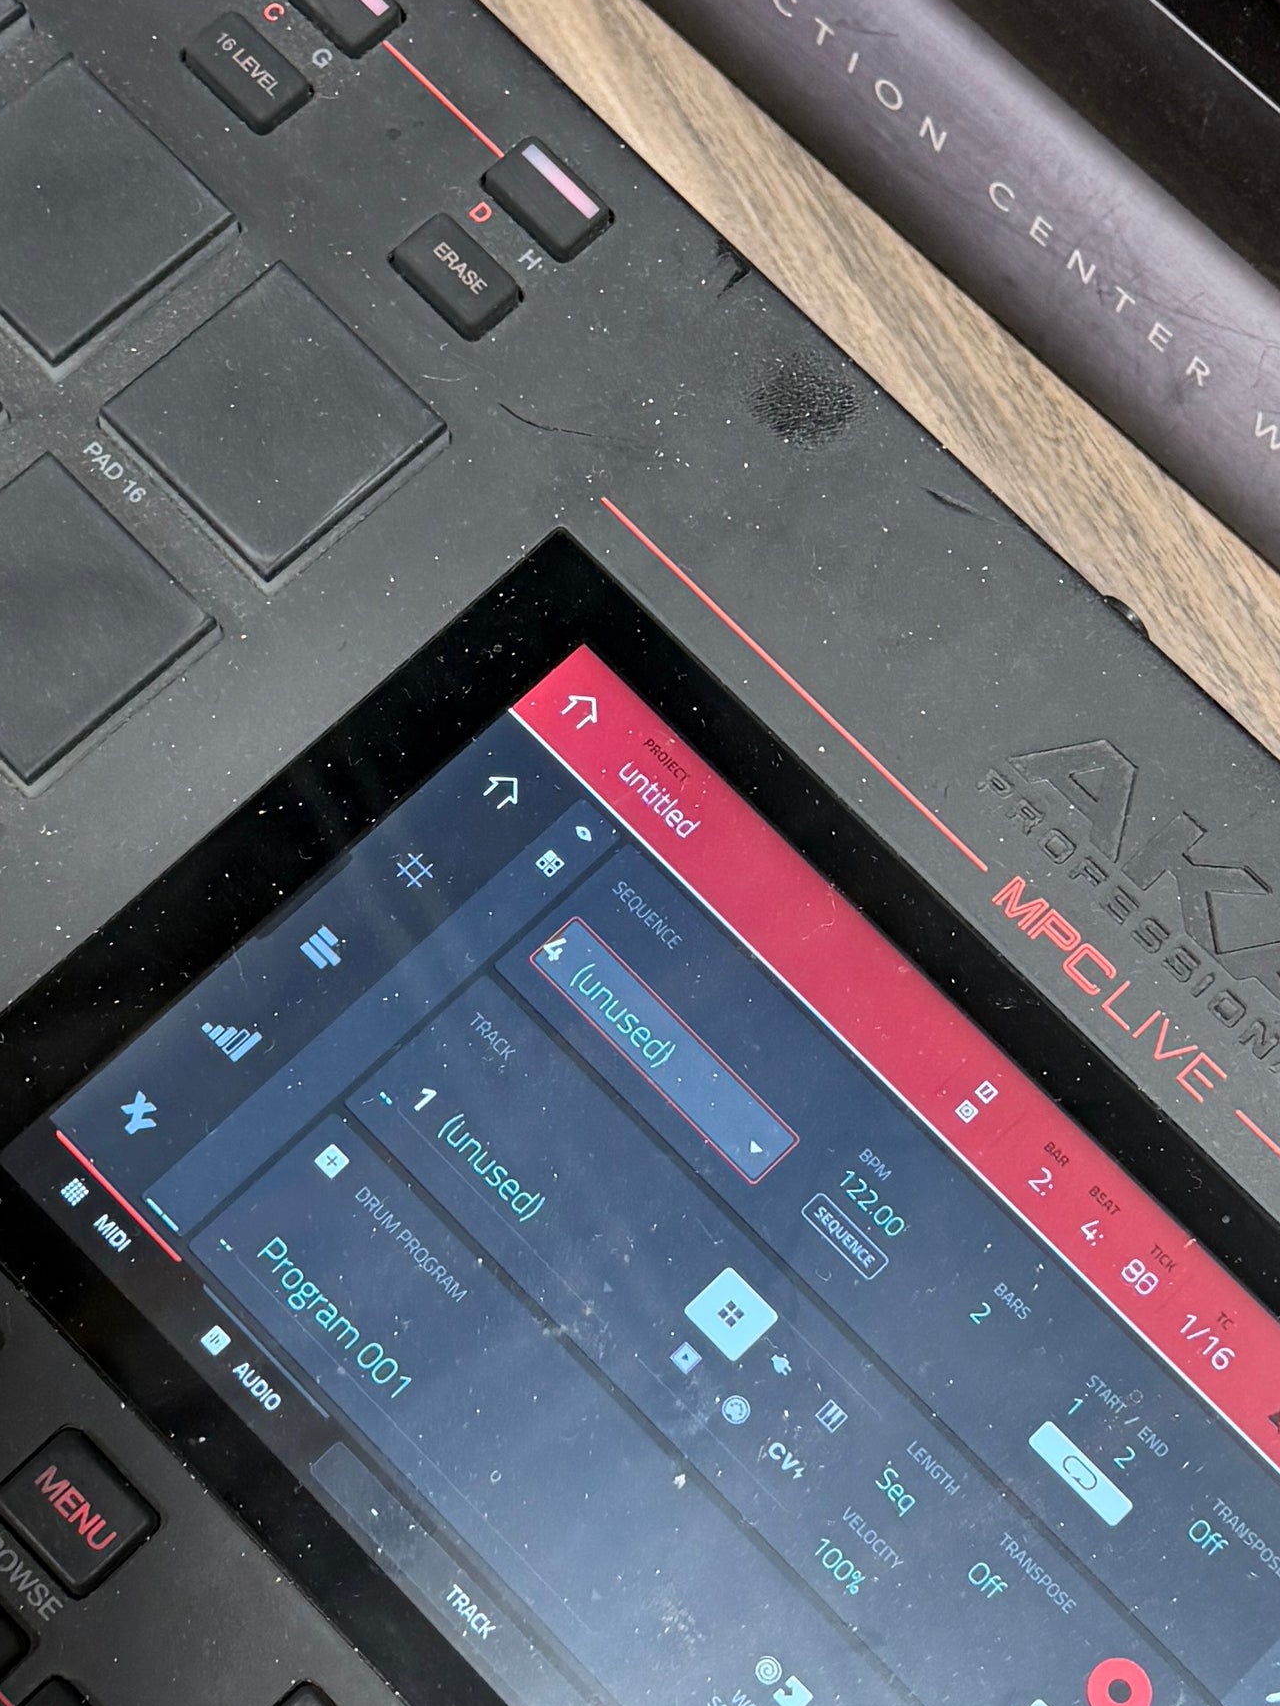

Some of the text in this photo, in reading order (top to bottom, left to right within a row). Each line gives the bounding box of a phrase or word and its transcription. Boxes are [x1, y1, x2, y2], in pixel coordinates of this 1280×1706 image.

[216, 31, 283, 98] 16 LEVEL
[433, 241, 488, 296] ERASE
[988, 181, 1213, 387] CENTER
[84, 440, 147, 504] PAD 16
[618, 759, 702, 840] untitled
[611, 879, 684, 951] SEQUENCE
[542, 937, 677, 1070] 4 (unused)
[469, 1011, 517, 1061] TRACK
[414, 1087, 547, 1223] 1 (unused)
[858, 1148, 893, 1182] BPM
[1043, 1141, 1070, 1168] BAR
[839, 1169, 905, 1237] 122.00
[1088, 1185, 1122, 1217] BEAT
[94, 1212, 132, 1254] MIDI
[354, 1185, 469, 1303] DRUM PROGRAM
[813, 1205, 877, 1270] SEQUENCE
[1149, 1244, 1178, 1273] TICK
[257, 1236, 413, 1400] Program 001
[969, 1301, 992, 1325] 2
[993, 1283, 1032, 1321] BARS
[1179, 1312, 1236, 1371] 1/16
[231, 1361, 282, 1413] AUDIO
[874, 1466, 917, 1518] Seq
[905, 1439, 962, 1497] LENGTH
[33, 1464, 119, 1554] MENU
[841, 1506, 904, 1570] VELOCITY
[1187, 1519, 1231, 1558] Off
[814, 1537, 867, 1596] 100%
[966, 1561, 1008, 1600] Off
[999, 1531, 1077, 1615] TRANSPOSE
[444, 1582, 497, 1641] TRACK
